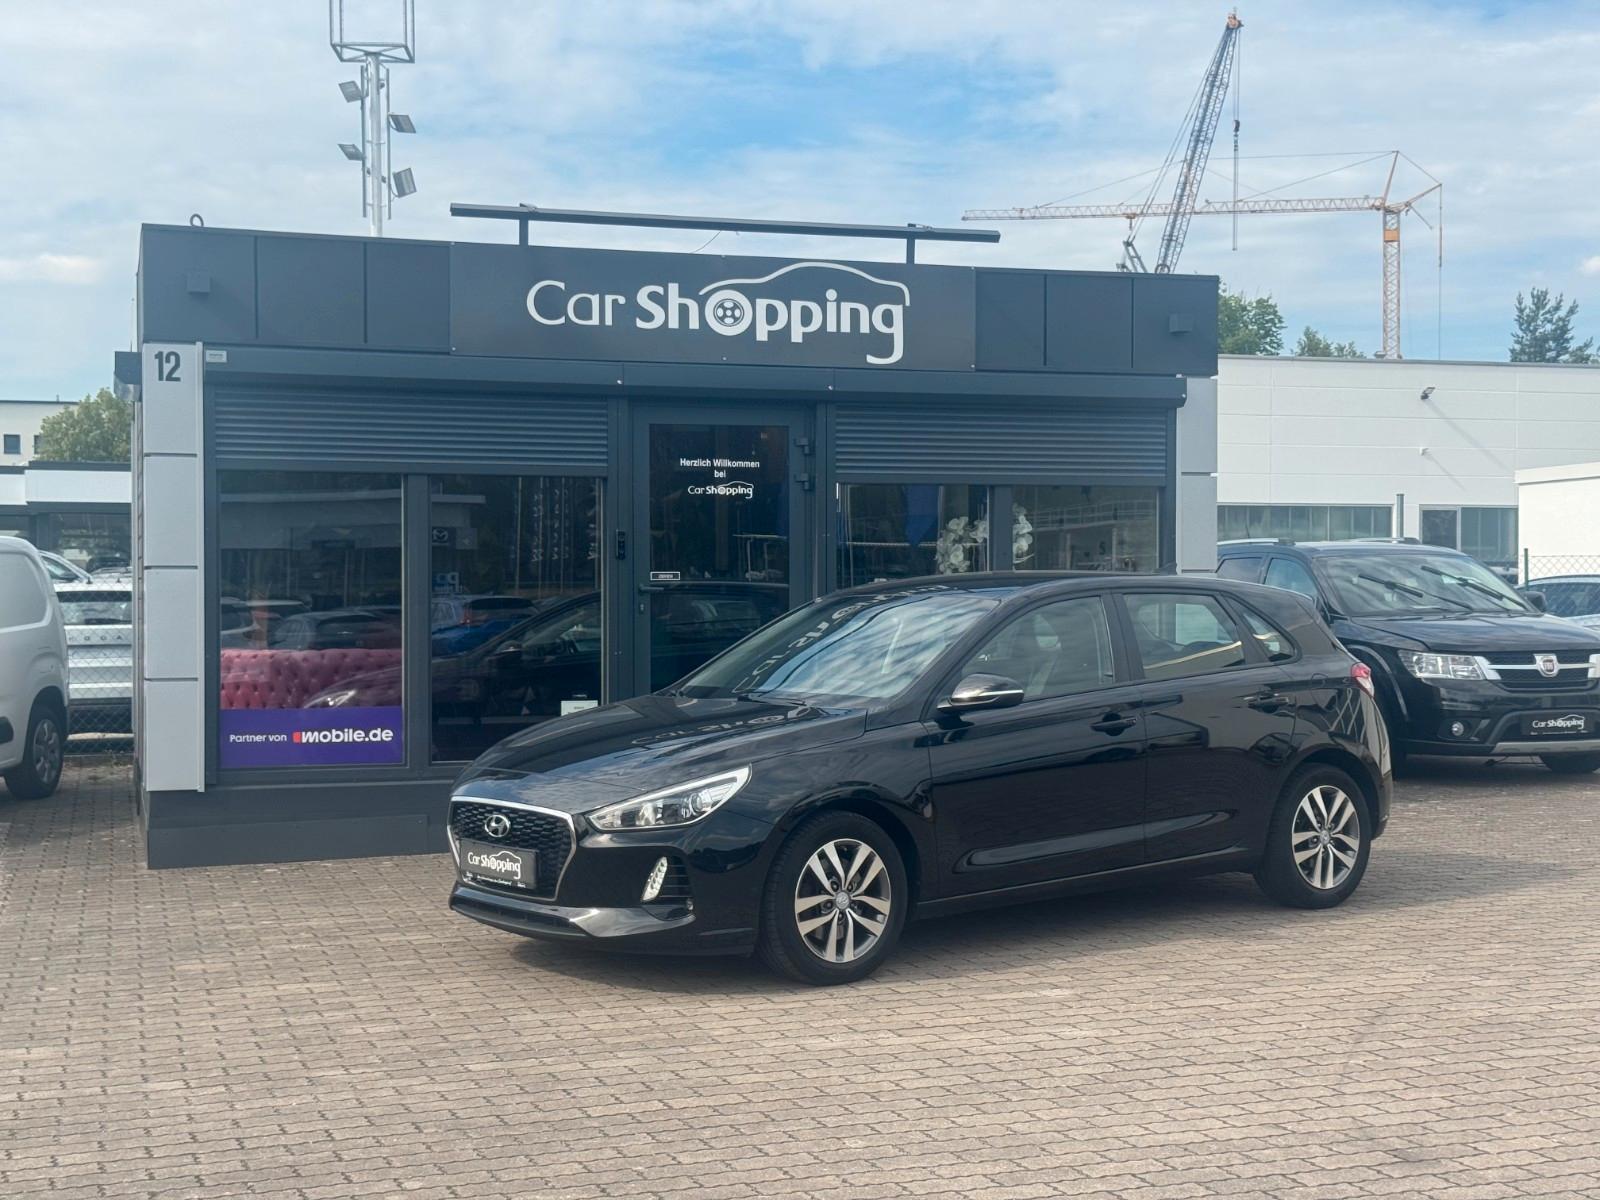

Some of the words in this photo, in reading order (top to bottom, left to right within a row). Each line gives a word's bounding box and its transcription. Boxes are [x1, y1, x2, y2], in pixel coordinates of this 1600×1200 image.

[526, 279, 626, 327] Car
[636, 281, 905, 365] Shopping
[154, 350, 182, 382] 12
[680, 458, 711, 467] Herzlich
[713, 459, 760, 468] Willkommen
[714, 469, 727, 478] bei
[687, 485, 705, 495] Car
[705, 484, 753, 499] Shopping
[1532, 720, 1547, 728] Car
[1547, 718, 1585, 730] Shopping
[229, 734, 266, 743] Partner
[268, 734, 287, 742] von
[301, 728, 394, 743] mobile.de
[467, 852, 481, 865] Car
[480, 854, 522, 880] Shopping
